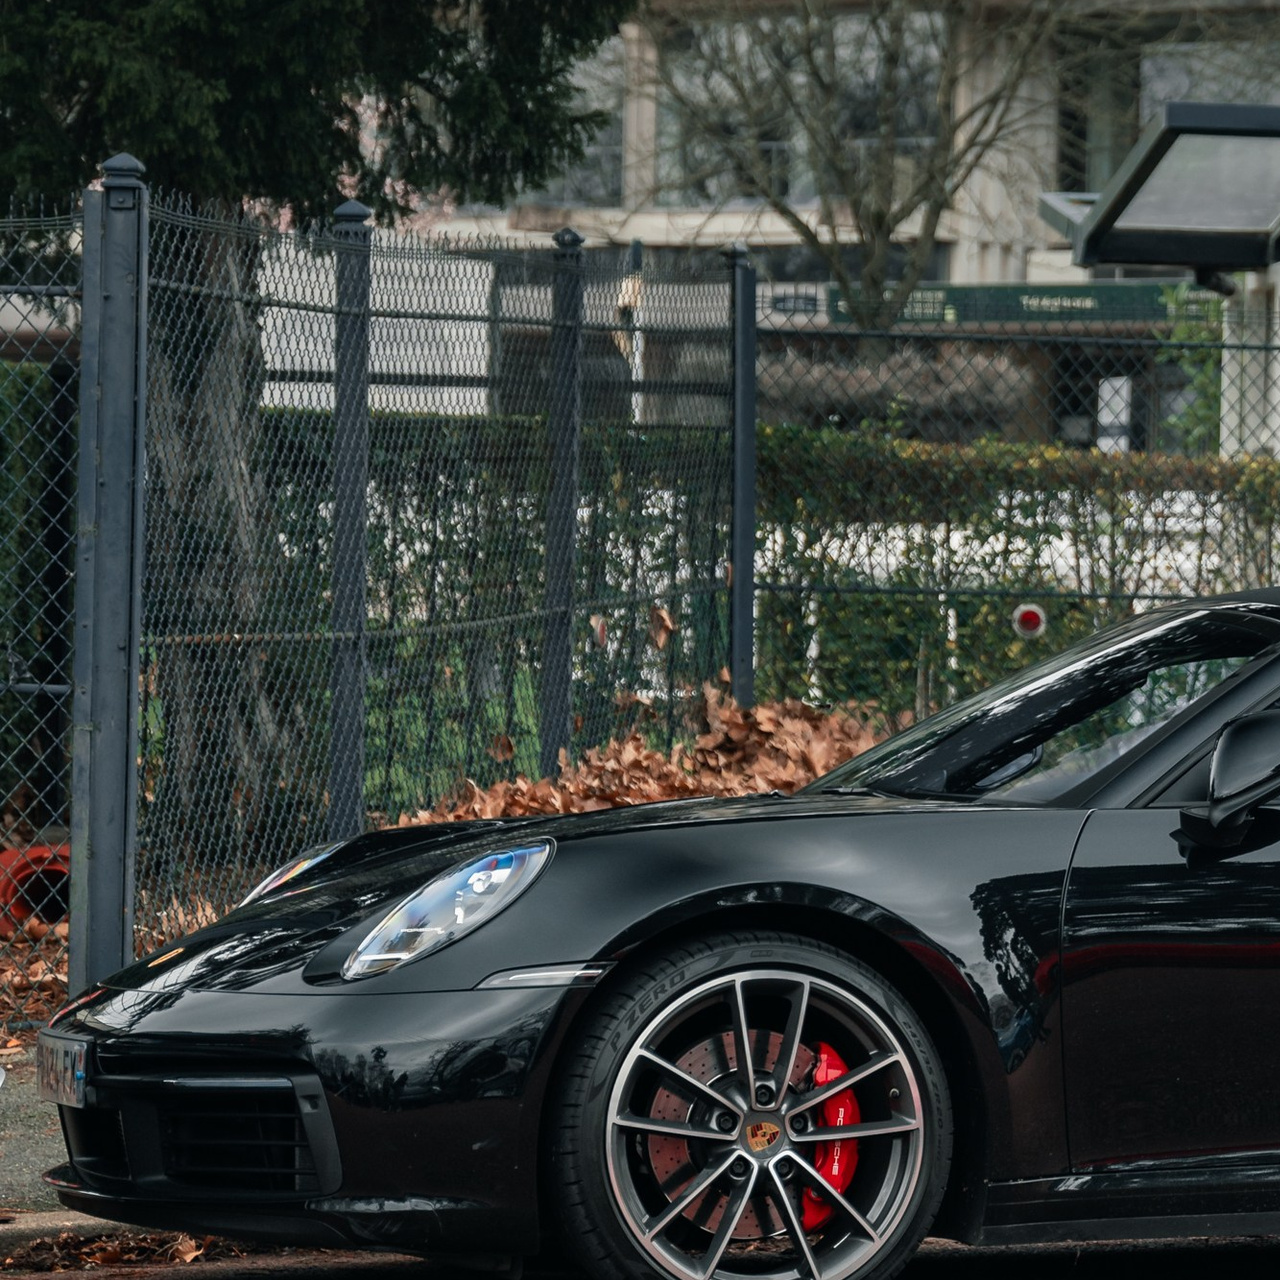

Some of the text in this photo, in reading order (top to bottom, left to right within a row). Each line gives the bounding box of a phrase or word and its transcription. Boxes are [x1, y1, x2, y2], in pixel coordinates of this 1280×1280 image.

[610, 970, 686, 1053] P ZERO
[832, 1107, 845, 1176] POSCHE
